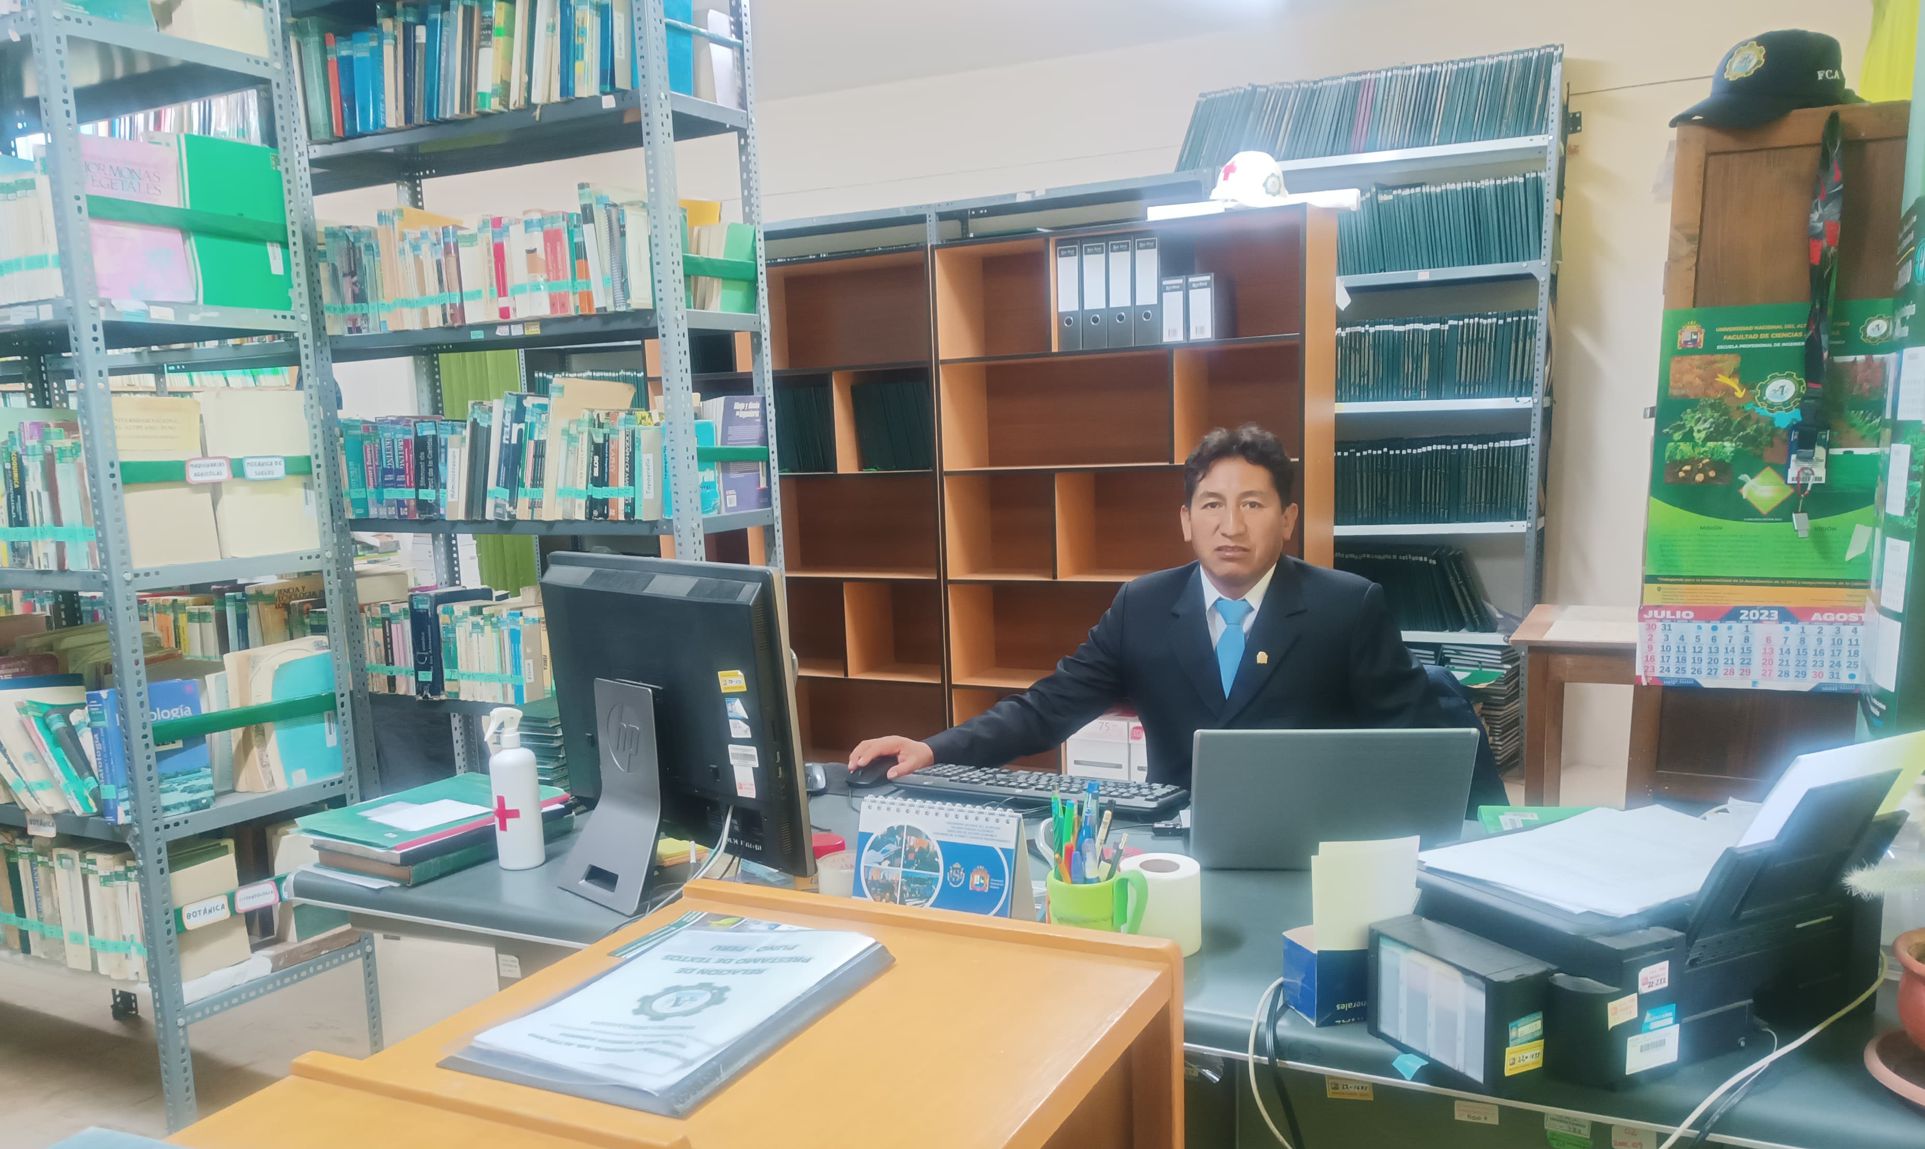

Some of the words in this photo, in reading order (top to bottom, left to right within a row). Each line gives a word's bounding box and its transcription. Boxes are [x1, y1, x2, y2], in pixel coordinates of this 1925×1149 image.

[1817, 70, 1840, 80] FCA
[91, 175, 162, 195] EGETALES
[1643, 610, 1694, 619] JULIO
[1739, 609, 1778, 620] 2023
[1811, 612, 1864, 621] AGOST
[1800, 626, 1805, 634] 1
[1817, 626, 1823, 634] 2
[1766, 636, 1771, 644] 6
[1799, 637, 1806, 645] 8
[1816, 637, 1823, 645] 9
[1676, 645, 1687, 653] 11
[1708, 646, 1719, 654] 13
[1763, 647, 1774, 655] 13
[1796, 648, 1808, 656] 15
[1830, 649, 1842, 657] 17
[1676, 656, 1687, 664] 18
[1707, 657, 1719, 665] 20
[1846, 661, 1859, 669] 25
[1691, 667, 1702, 675] 26
[1723, 668, 1735, 676] 28
[1777, 670, 1790, 678] 28
[1812, 671, 1824, 679] 30
[150, 705, 192, 721] ología
[186, 903, 226, 919] BOTÁNICA
[661, 954, 712, 963] TEXTOS
[713, 956, 734, 964] DE
